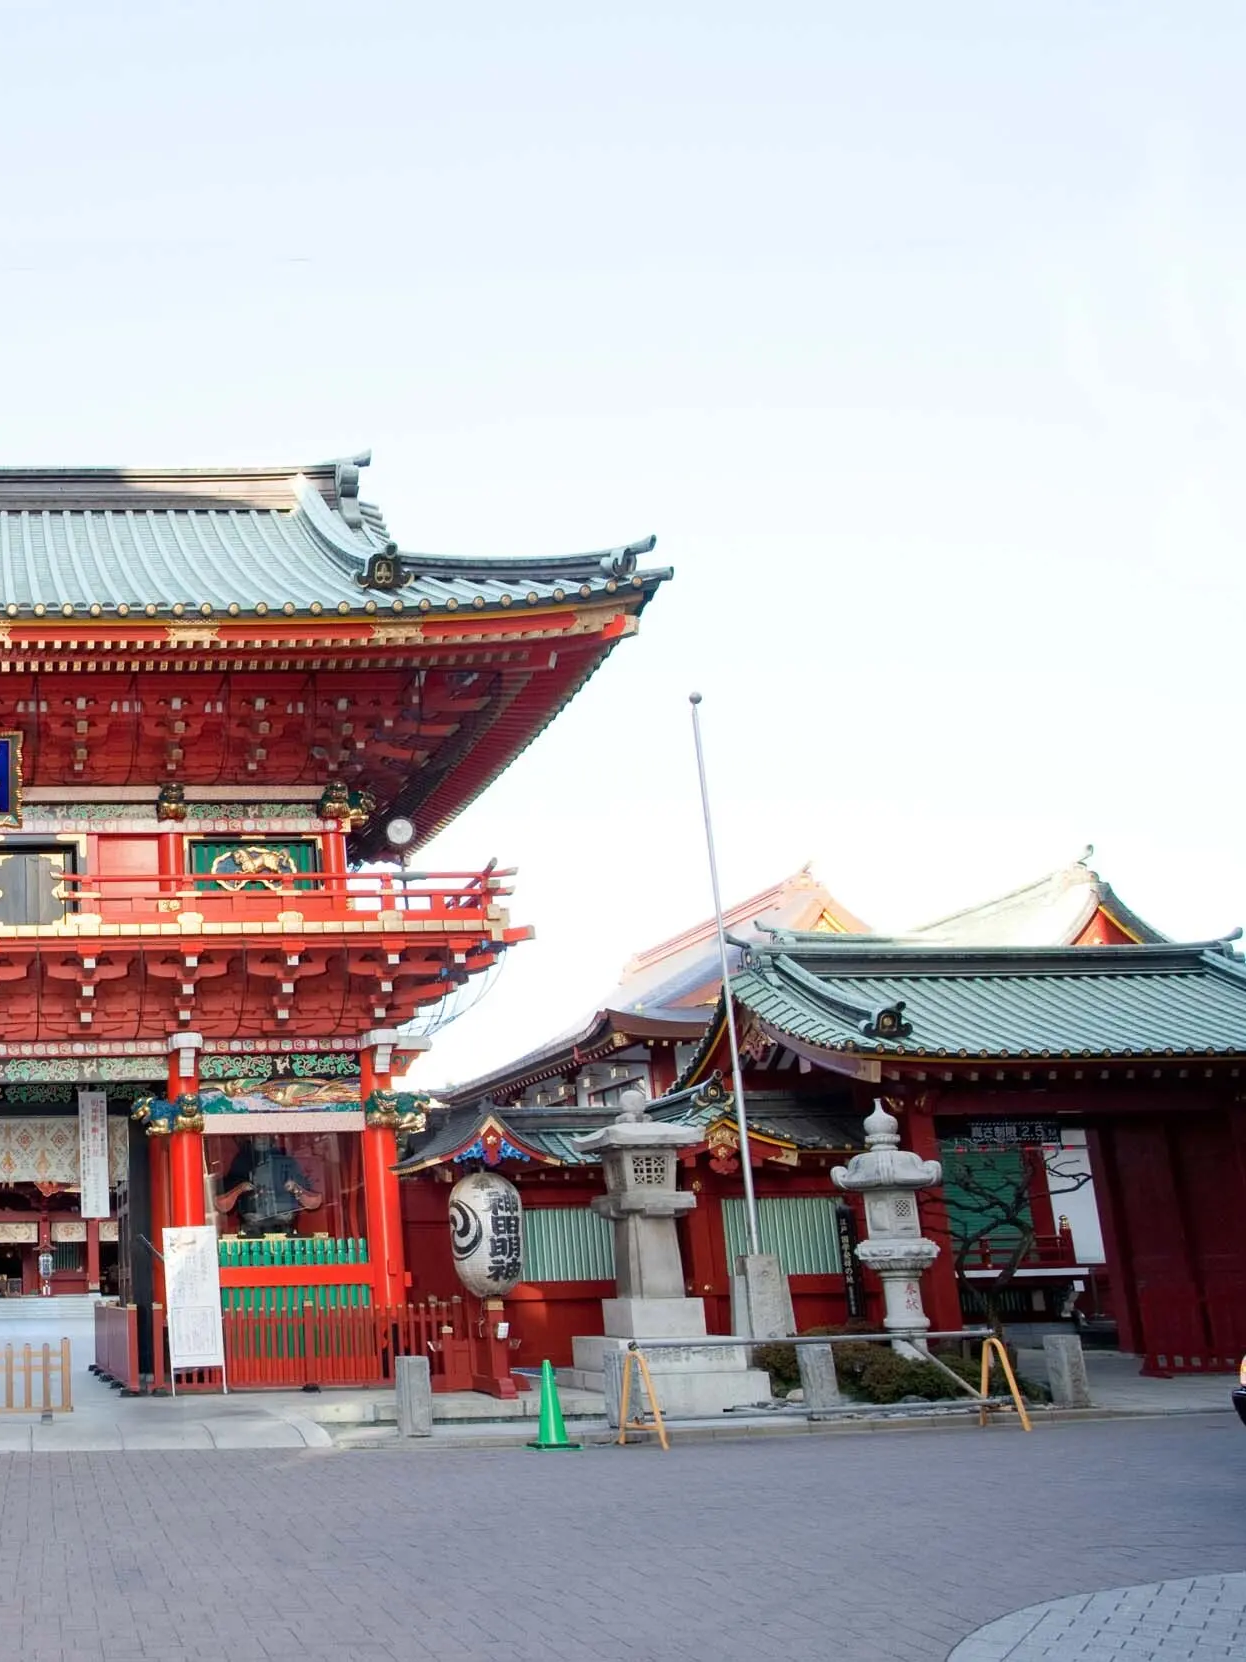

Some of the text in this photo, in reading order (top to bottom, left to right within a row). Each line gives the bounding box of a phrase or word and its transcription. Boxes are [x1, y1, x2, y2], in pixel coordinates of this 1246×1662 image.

[1021, 1125, 1043, 1137] 2.5
[486, 1190, 521, 1281] 神田明神
